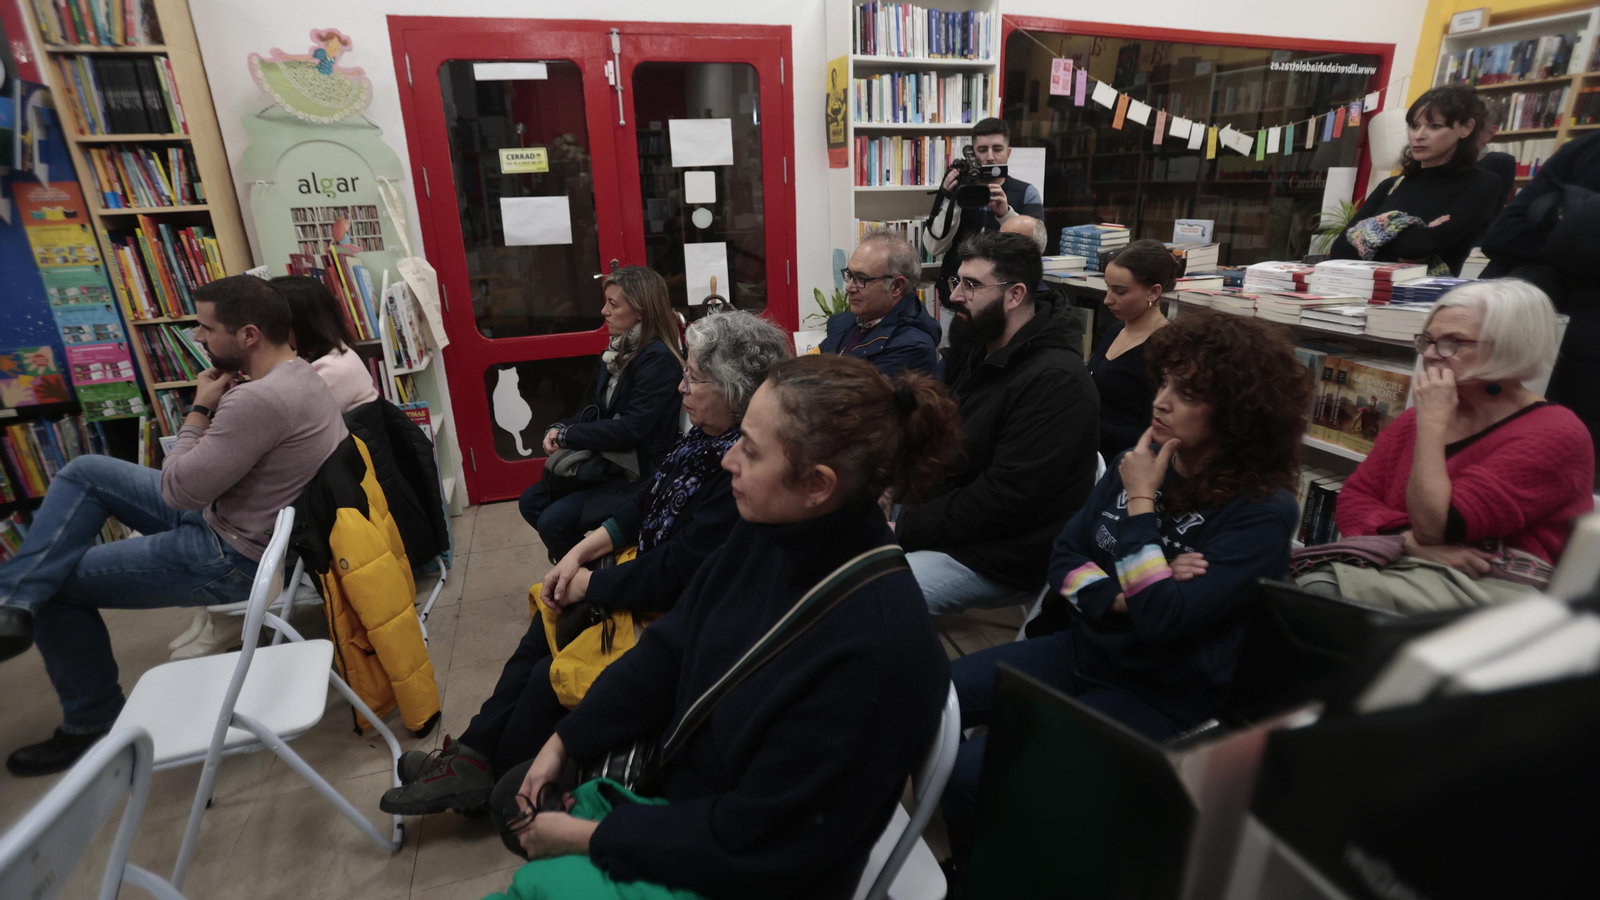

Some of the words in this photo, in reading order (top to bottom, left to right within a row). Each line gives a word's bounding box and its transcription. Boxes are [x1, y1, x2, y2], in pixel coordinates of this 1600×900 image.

[298, 172, 360, 199] algar
[1289, 173, 1326, 190] CaixaBa
[1366, 376, 1404, 393] SANGRE
[1366, 385, 1399, 400] PADRE
